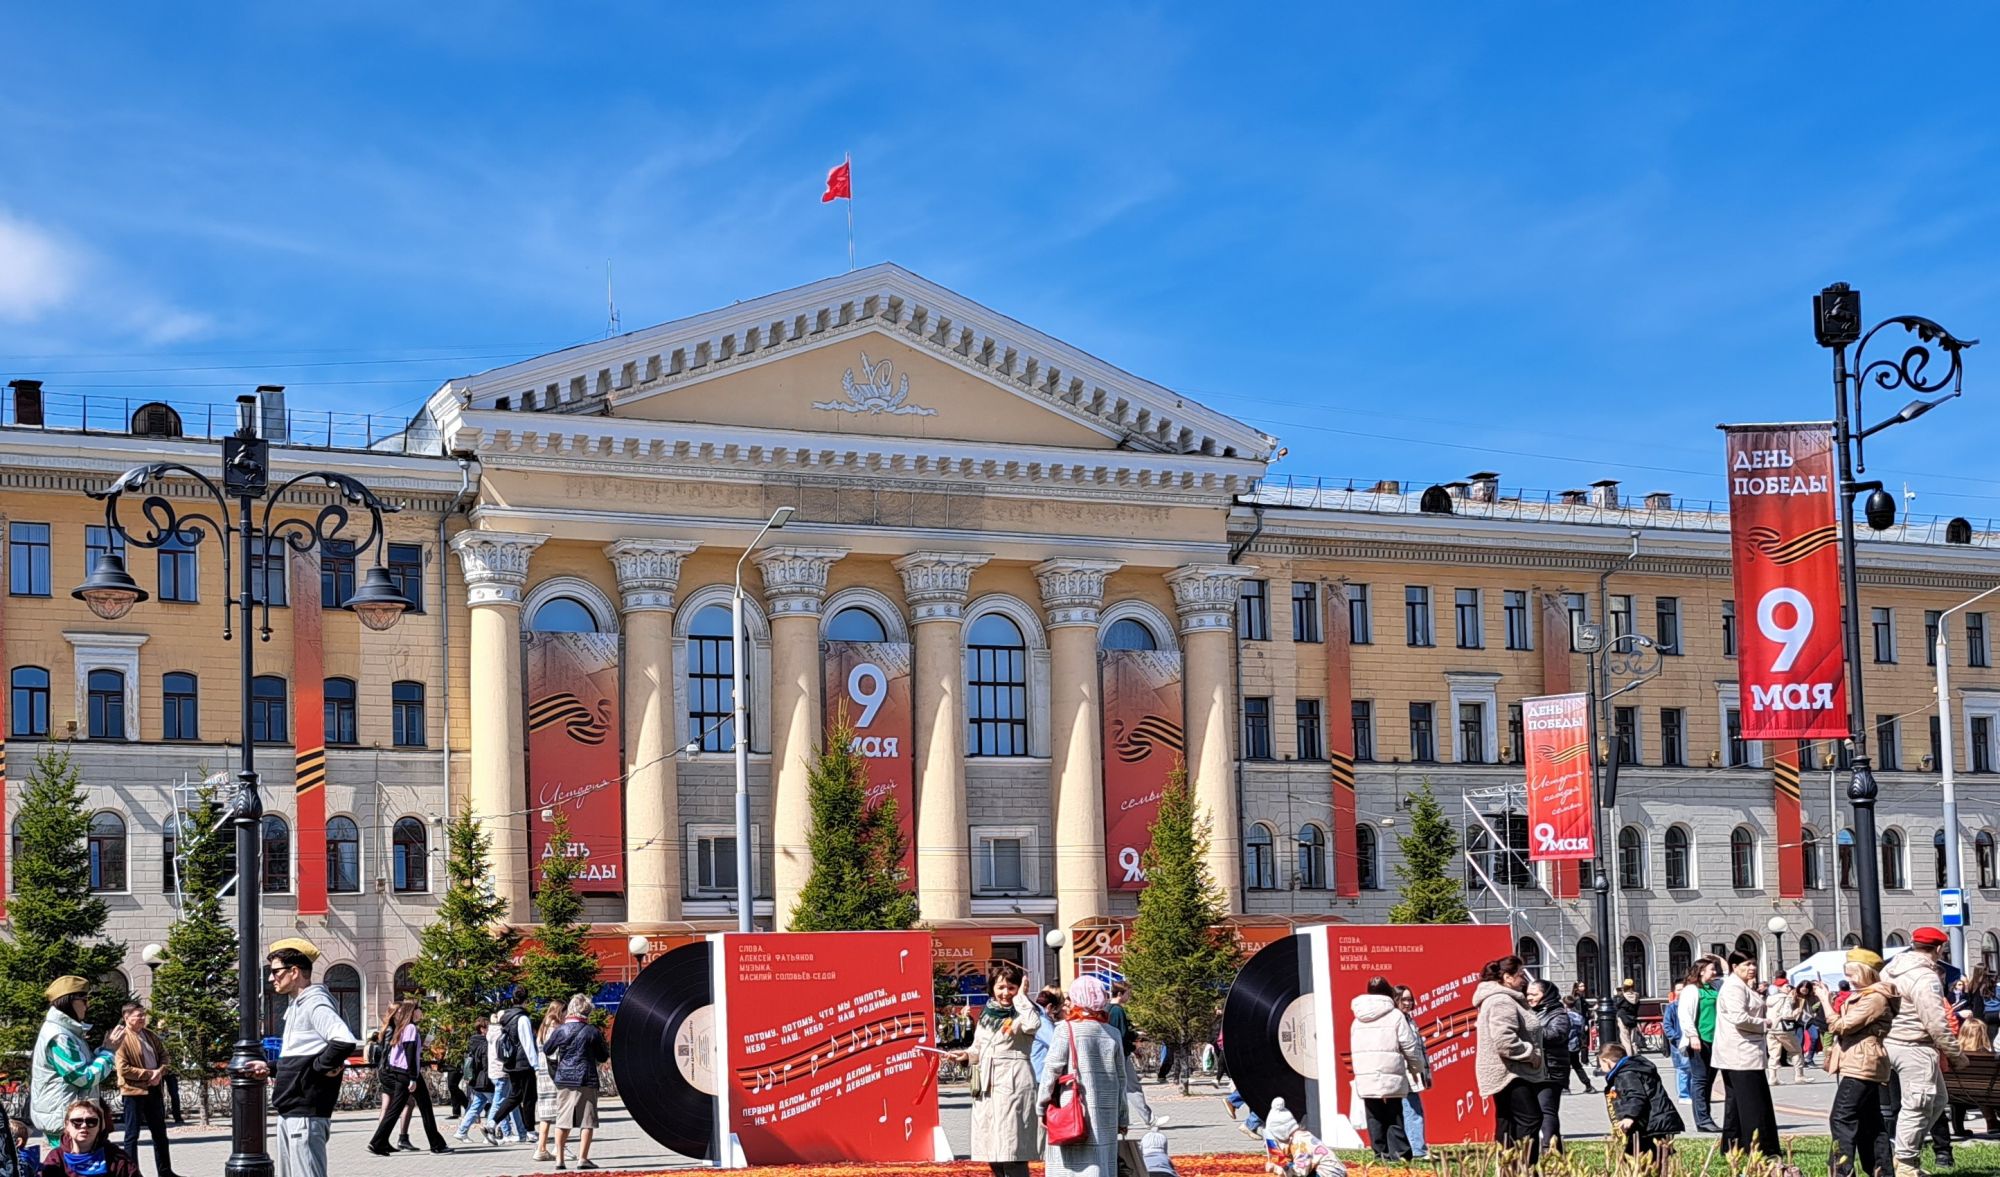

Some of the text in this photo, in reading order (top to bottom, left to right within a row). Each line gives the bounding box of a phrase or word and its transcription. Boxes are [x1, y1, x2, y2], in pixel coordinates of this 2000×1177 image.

[1733, 449, 1794, 472] ДЕНЬ
[1733, 474, 1828, 496] ПОБЕДЫ
[1756, 587, 1814, 673] 9
[847, 662, 888, 728] 9
[1751, 682, 1833, 711] мая
[1528, 704, 1563, 717] ДЕНЬ
[1528, 717, 1584, 731] ПОБЕДЫ
[739, 953, 772, 962] АЛЕКСЕЙ
[1340, 944, 1424, 953] ЕВГЕНИЙ ДОЛМАТОВСКИЙ
[739, 972, 772, 981] ВАСИЛИЙ
[1361, 963, 1393, 971] ФРАДКИН
[1420, 992, 1430, 1003] ПО
[1431, 979, 1460, 998] ГОРОДУ
[818, 1007, 834, 1019] ЧТО
[837, 1000, 851, 1012] МЫ
[745, 1042, 766, 1055] НЕБО
[803, 1022, 824, 1037] НЕБО
[838, 1010, 856, 1023] НАШ
[858, 994, 897, 1016] РОДИМЫЙ
[1432, 1046, 1476, 1072] ЗАПАД НАС
[742, 1103, 775, 1117] ПЕРВЫМ
[810, 1076, 842, 1097] ПЕРВЫМ
[846, 1063, 872, 1082] ДЕЛОМ
[771, 1113, 777, 1123] А
[781, 1097, 822, 1120] ДЕВУШКИ?
[836, 1088, 842, 1097] А
[846, 1070, 881, 1093] ДЕВУШКИ
